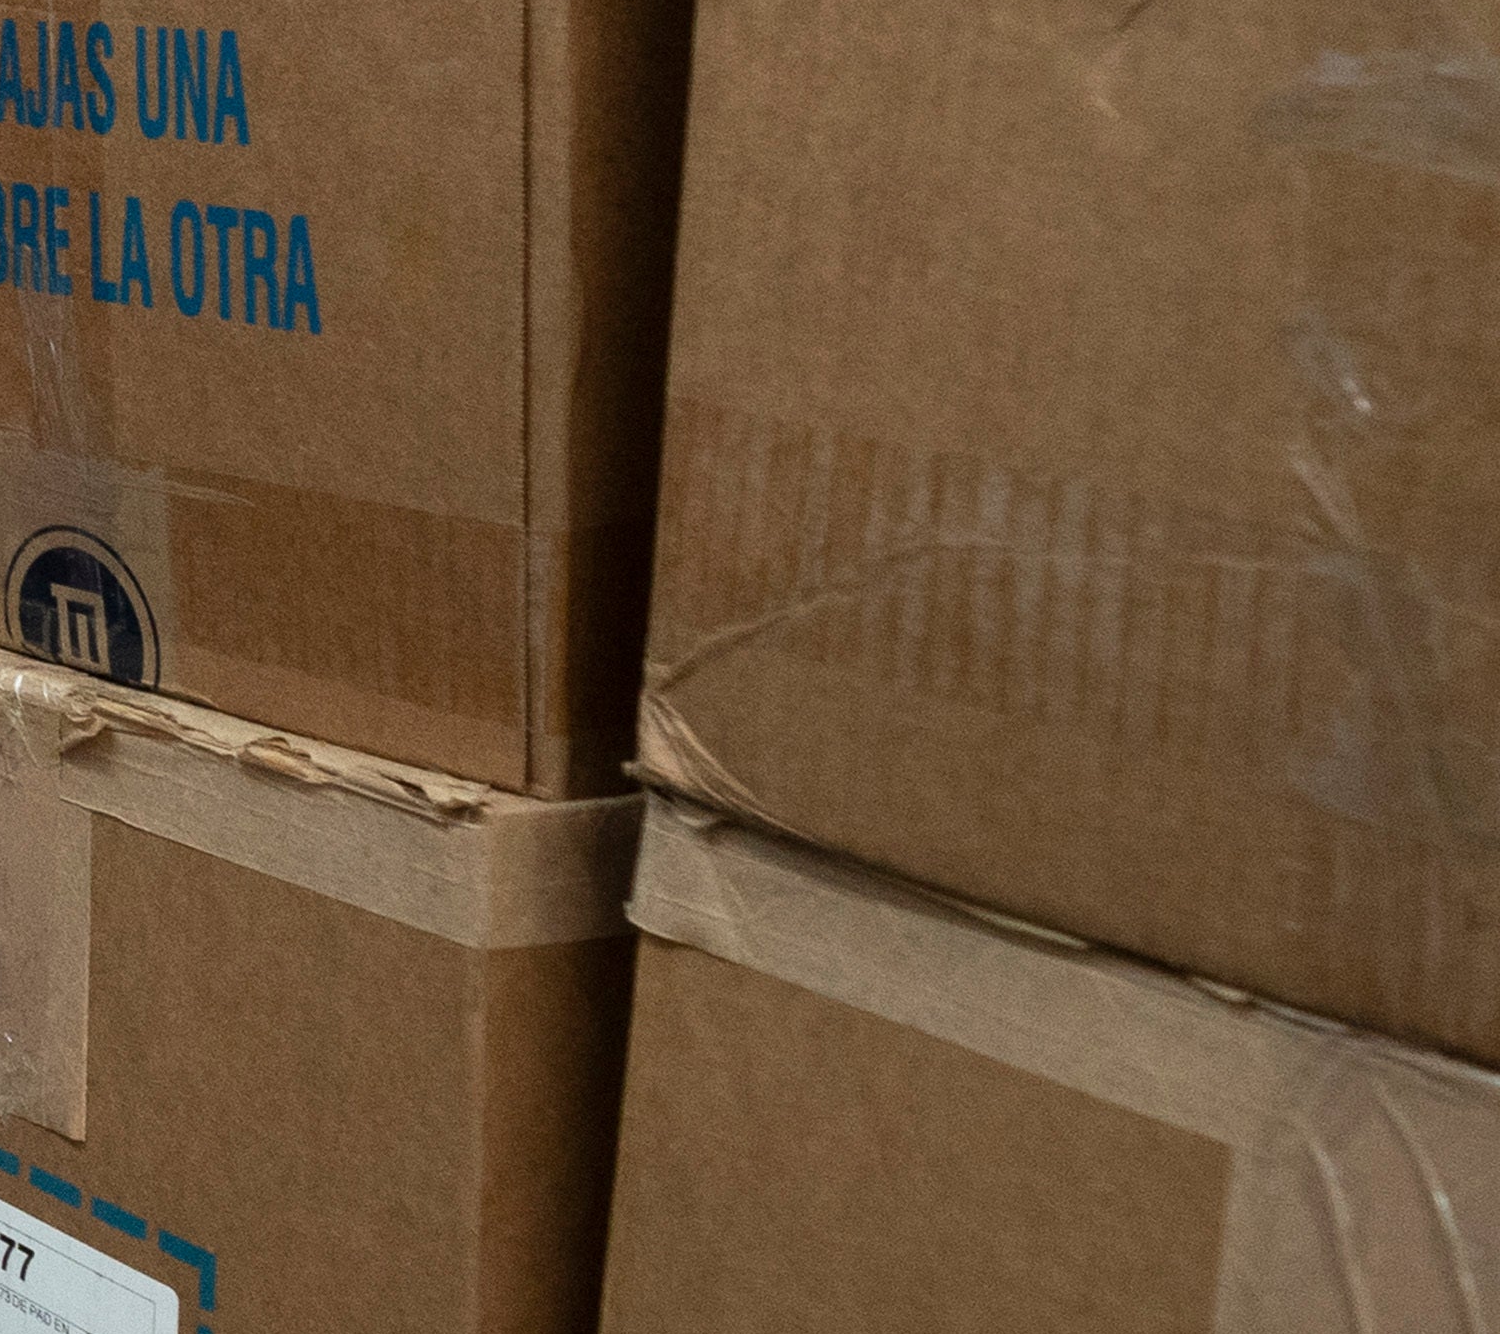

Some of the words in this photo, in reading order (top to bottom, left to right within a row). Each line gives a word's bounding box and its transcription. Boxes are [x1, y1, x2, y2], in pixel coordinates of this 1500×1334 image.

[134, 24, 251, 147] UNA
[90, 188, 154, 310] LA
[169, 198, 322, 336] OTRA
